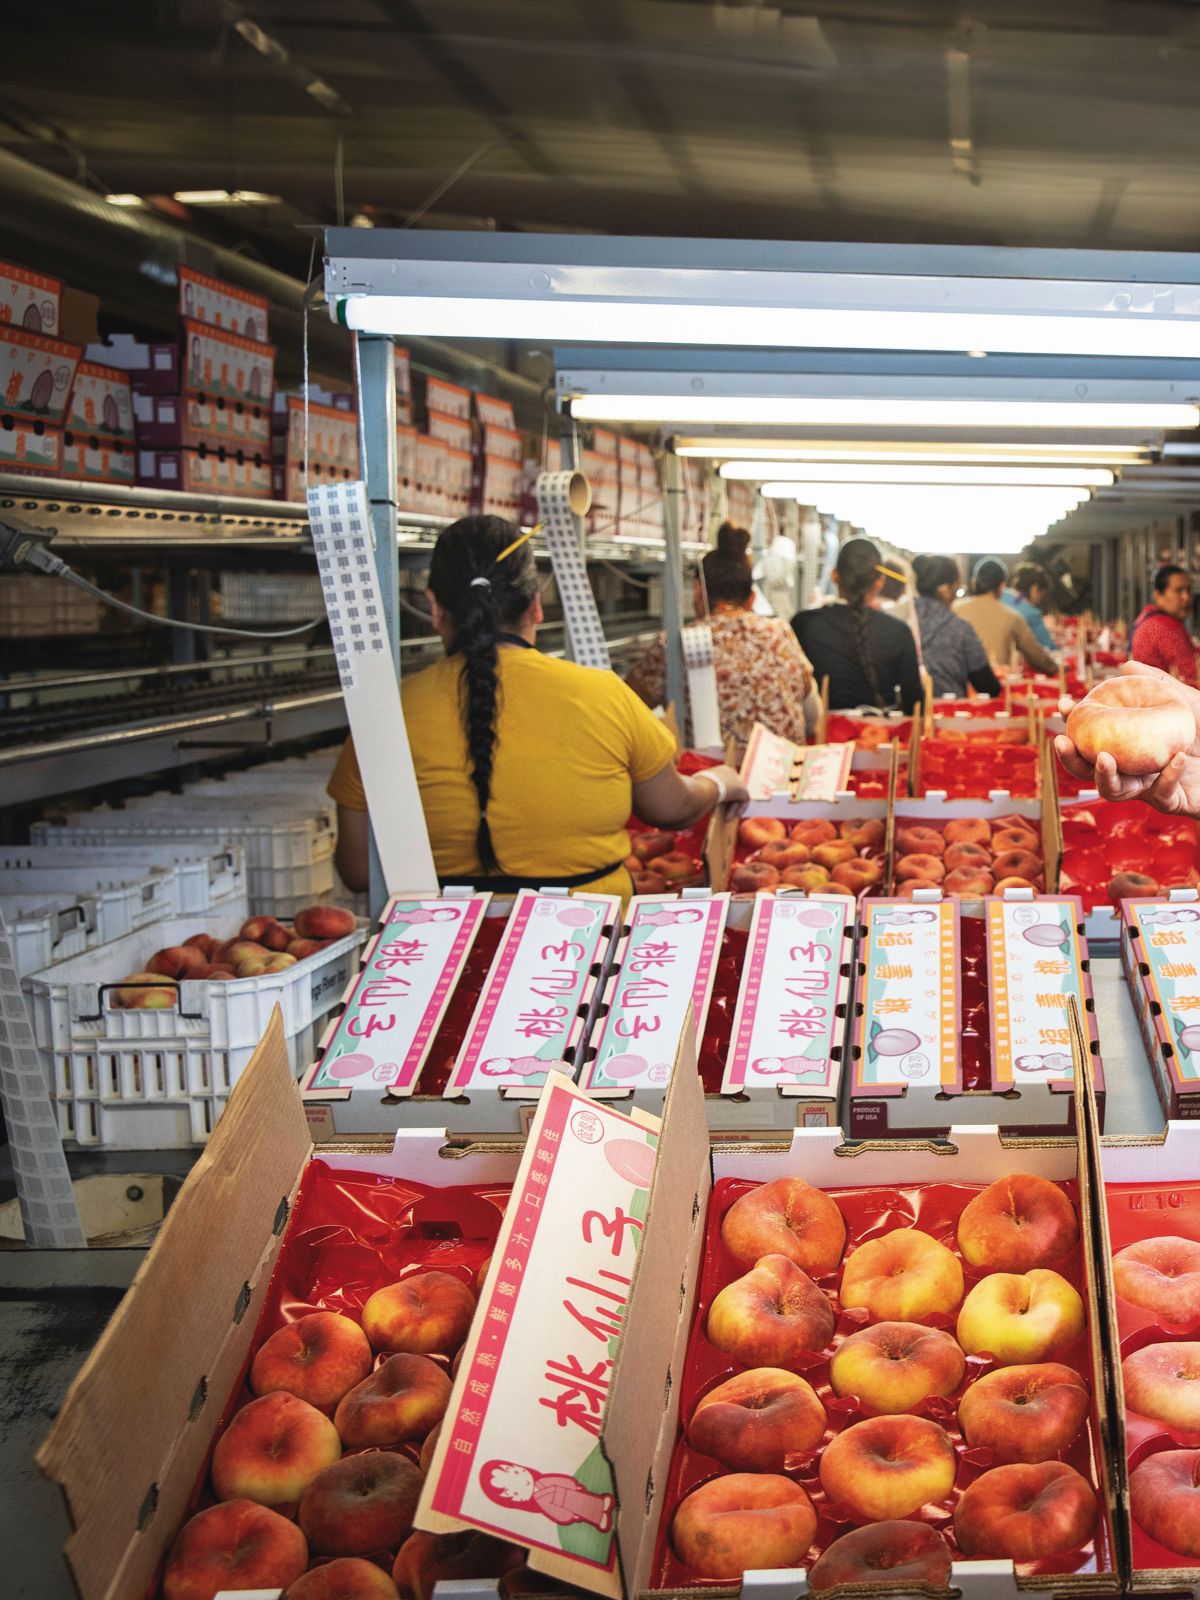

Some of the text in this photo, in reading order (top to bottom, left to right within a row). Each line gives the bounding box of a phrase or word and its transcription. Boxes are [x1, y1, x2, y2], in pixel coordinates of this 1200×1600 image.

[347, 938, 429, 1039] 桃仙子
[514, 939, 586, 1039] 桃仙子
[614, 940, 680, 1040] 桃仙子
[777, 940, 834, 1039] 桃仙子
[872, 931, 914, 1015] 福壽桃
[1033, 958, 1072, 1046] 福壽桃
[539, 1204, 645, 1439] 桃仙子
